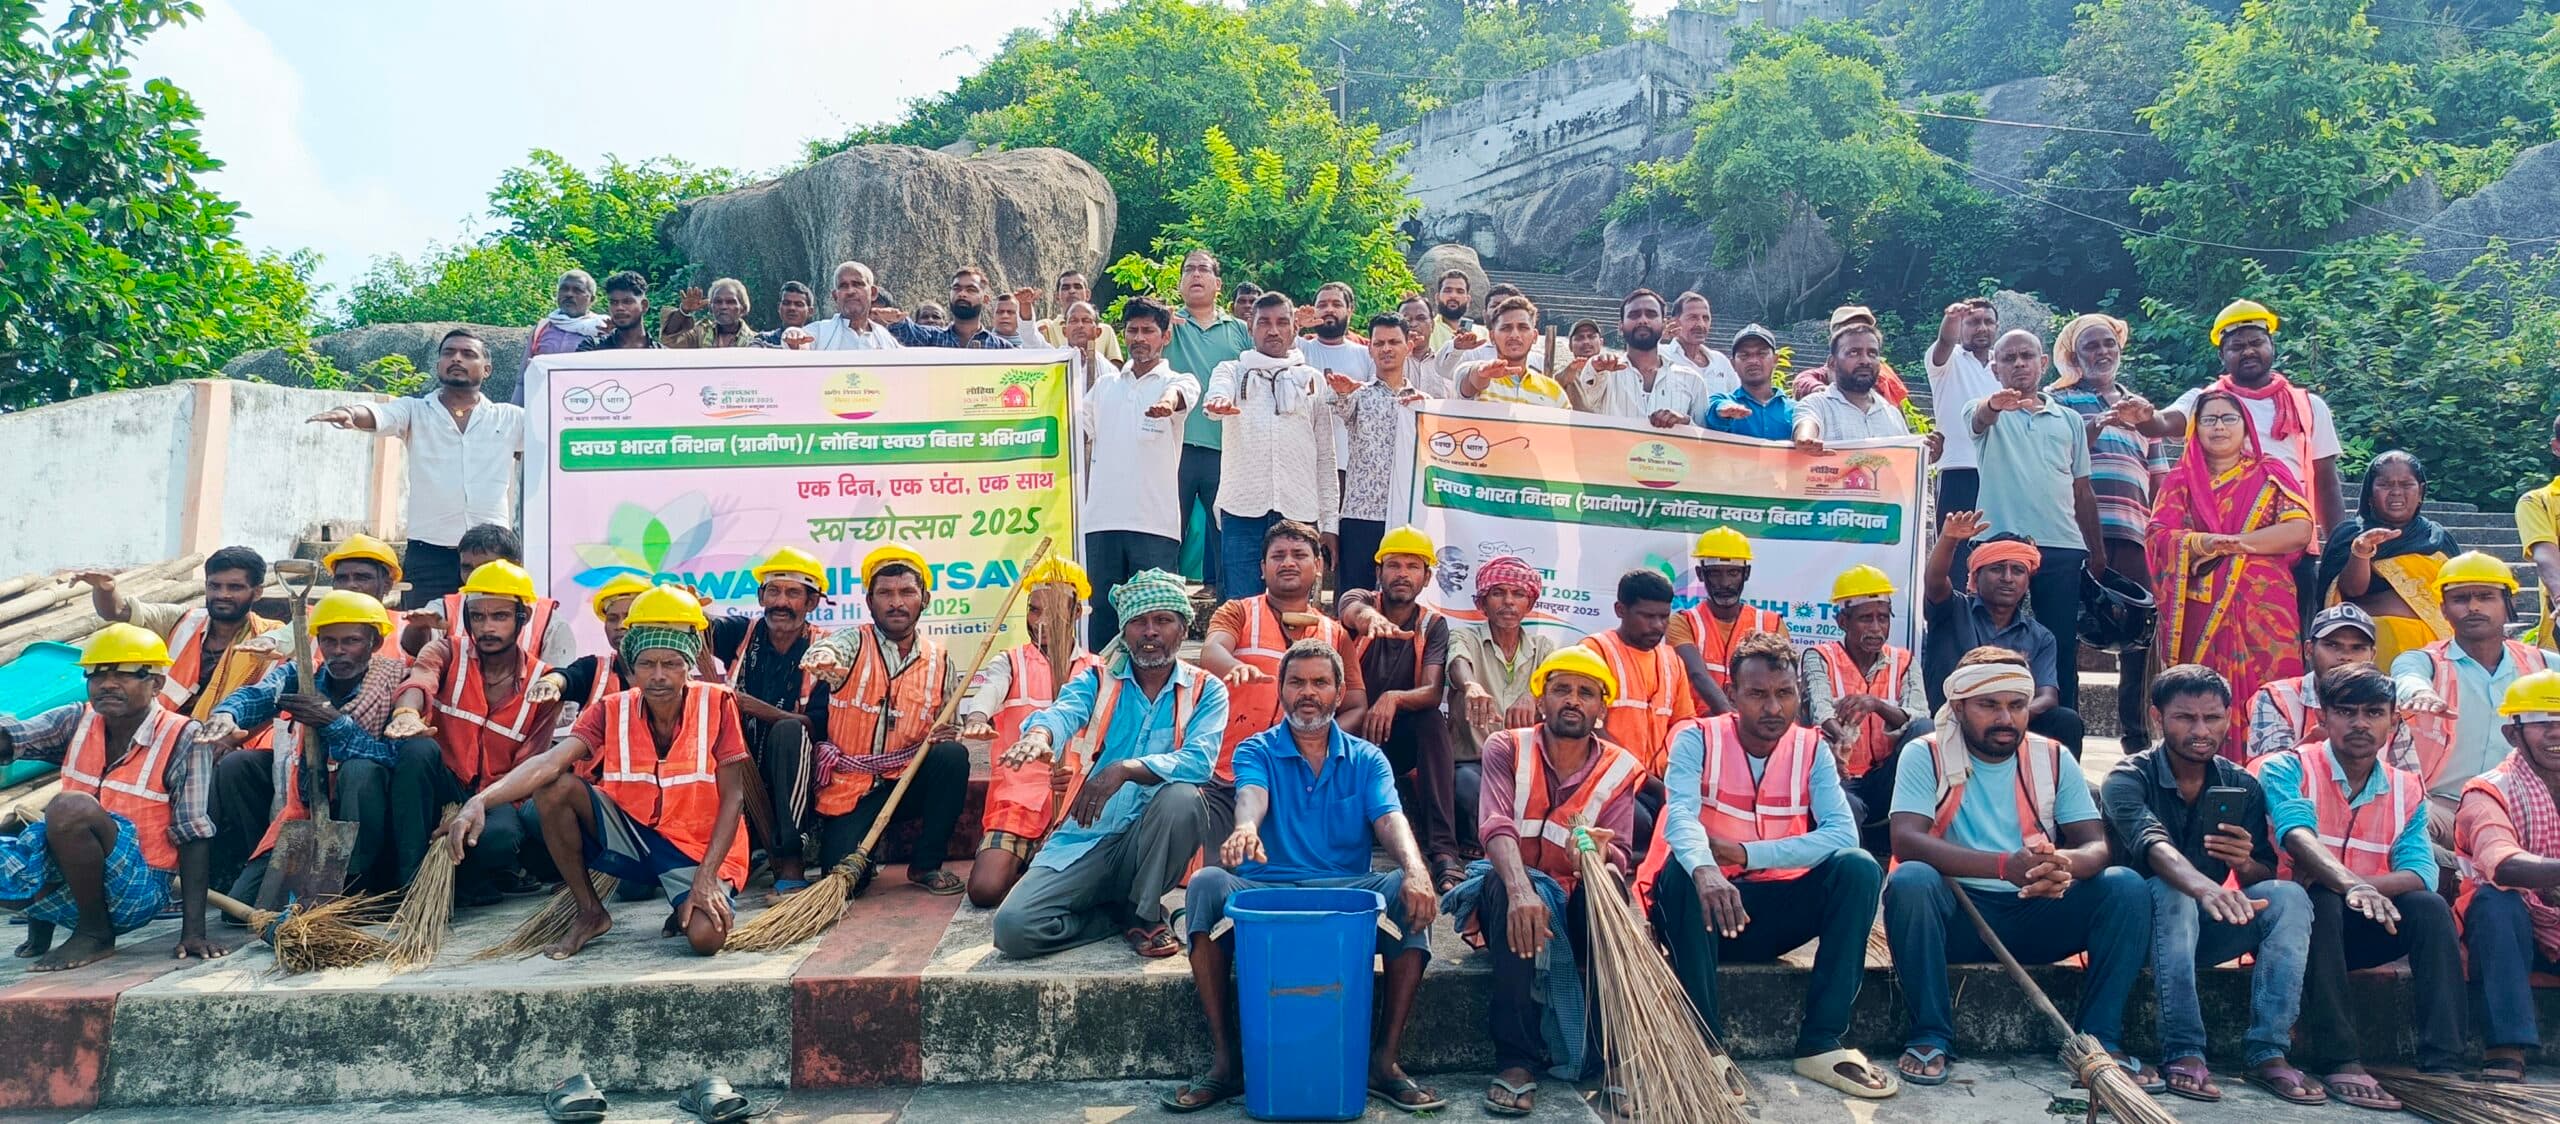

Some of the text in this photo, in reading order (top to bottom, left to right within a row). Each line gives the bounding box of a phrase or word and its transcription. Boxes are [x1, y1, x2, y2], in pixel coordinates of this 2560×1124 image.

[569, 440, 617, 457] स्वच्छ
[621, 438, 668, 455] भारत
[670, 435, 726, 454] मिशन
[819, 431, 879, 451] लोहिया
[882, 433, 928, 449] स्वच्छ
[928, 430, 976, 448] बिहार
[979, 427, 1048, 447] अभियान
[797, 471, 1055, 499] एक दिन, एक घंटा, एक साथ
[1432, 477, 1472, 498] स्वच्छ
[1475, 483, 1516, 504] भारत
[1520, 486, 1572, 508] मिशन
[1660, 497, 1719, 519] लोहिया
[1721, 506, 1766, 524] स्वच्छ
[1767, 505, 1815, 527] बिहार
[1817, 507, 1889, 531] अभियान
[968, 506, 1043, 537] 2025
[1552, 587, 1591, 602] 2025
[841, 603, 862, 620] Hi
[1573, 606, 1601, 617] 2025
[928, 622, 1008, 636] Initiatie
[1786, 621, 1812, 634] Seva
